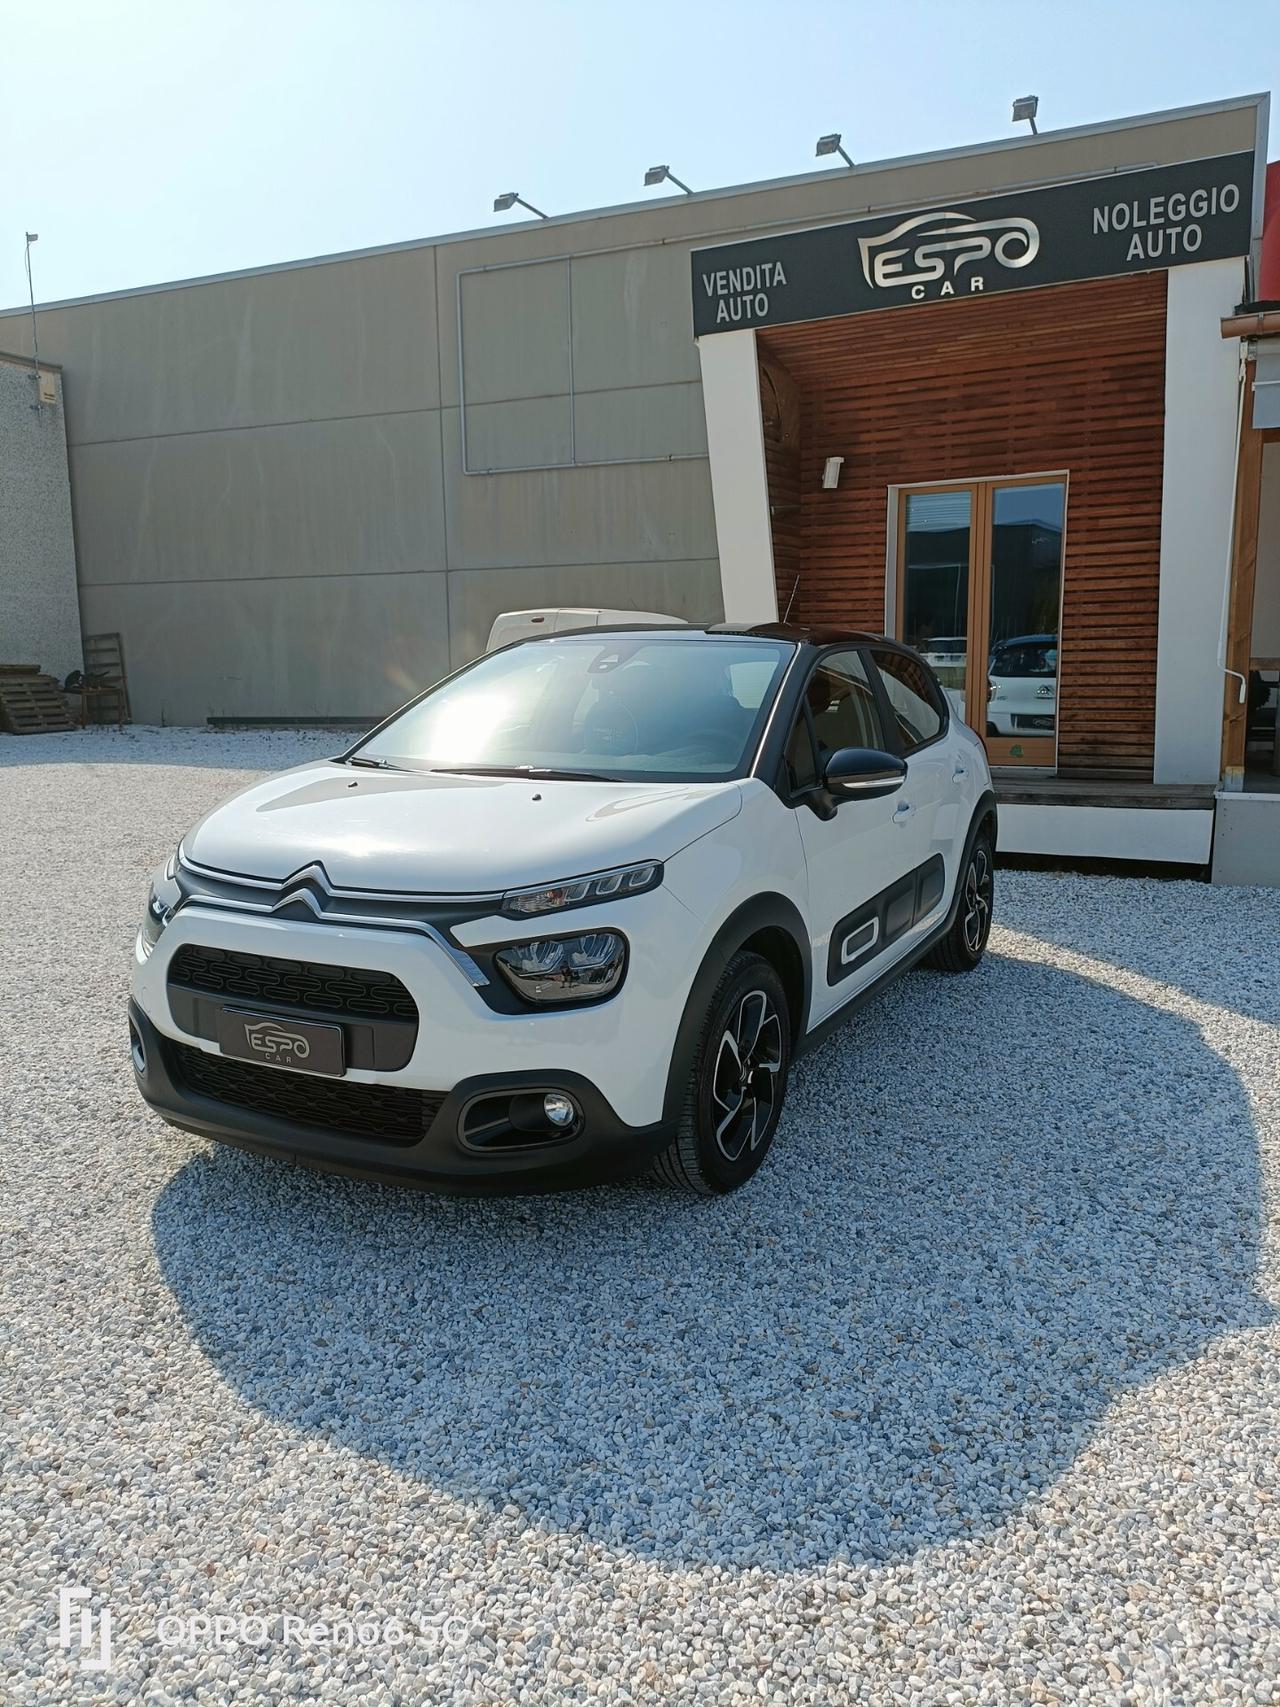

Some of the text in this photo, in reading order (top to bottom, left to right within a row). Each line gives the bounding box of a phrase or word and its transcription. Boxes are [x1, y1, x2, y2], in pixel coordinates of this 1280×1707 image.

[1093, 184, 1240, 234] NOLEGGIO
[872, 216, 1040, 288] ESPO
[1126, 224, 1202, 261] AUTO
[702, 261, 787, 297] VENDITA
[911, 276, 984, 299] CAR
[716, 293, 769, 323] AUTO
[250, 1028, 310, 1058] ESPO
[265, 1052, 292, 1063] CAR
